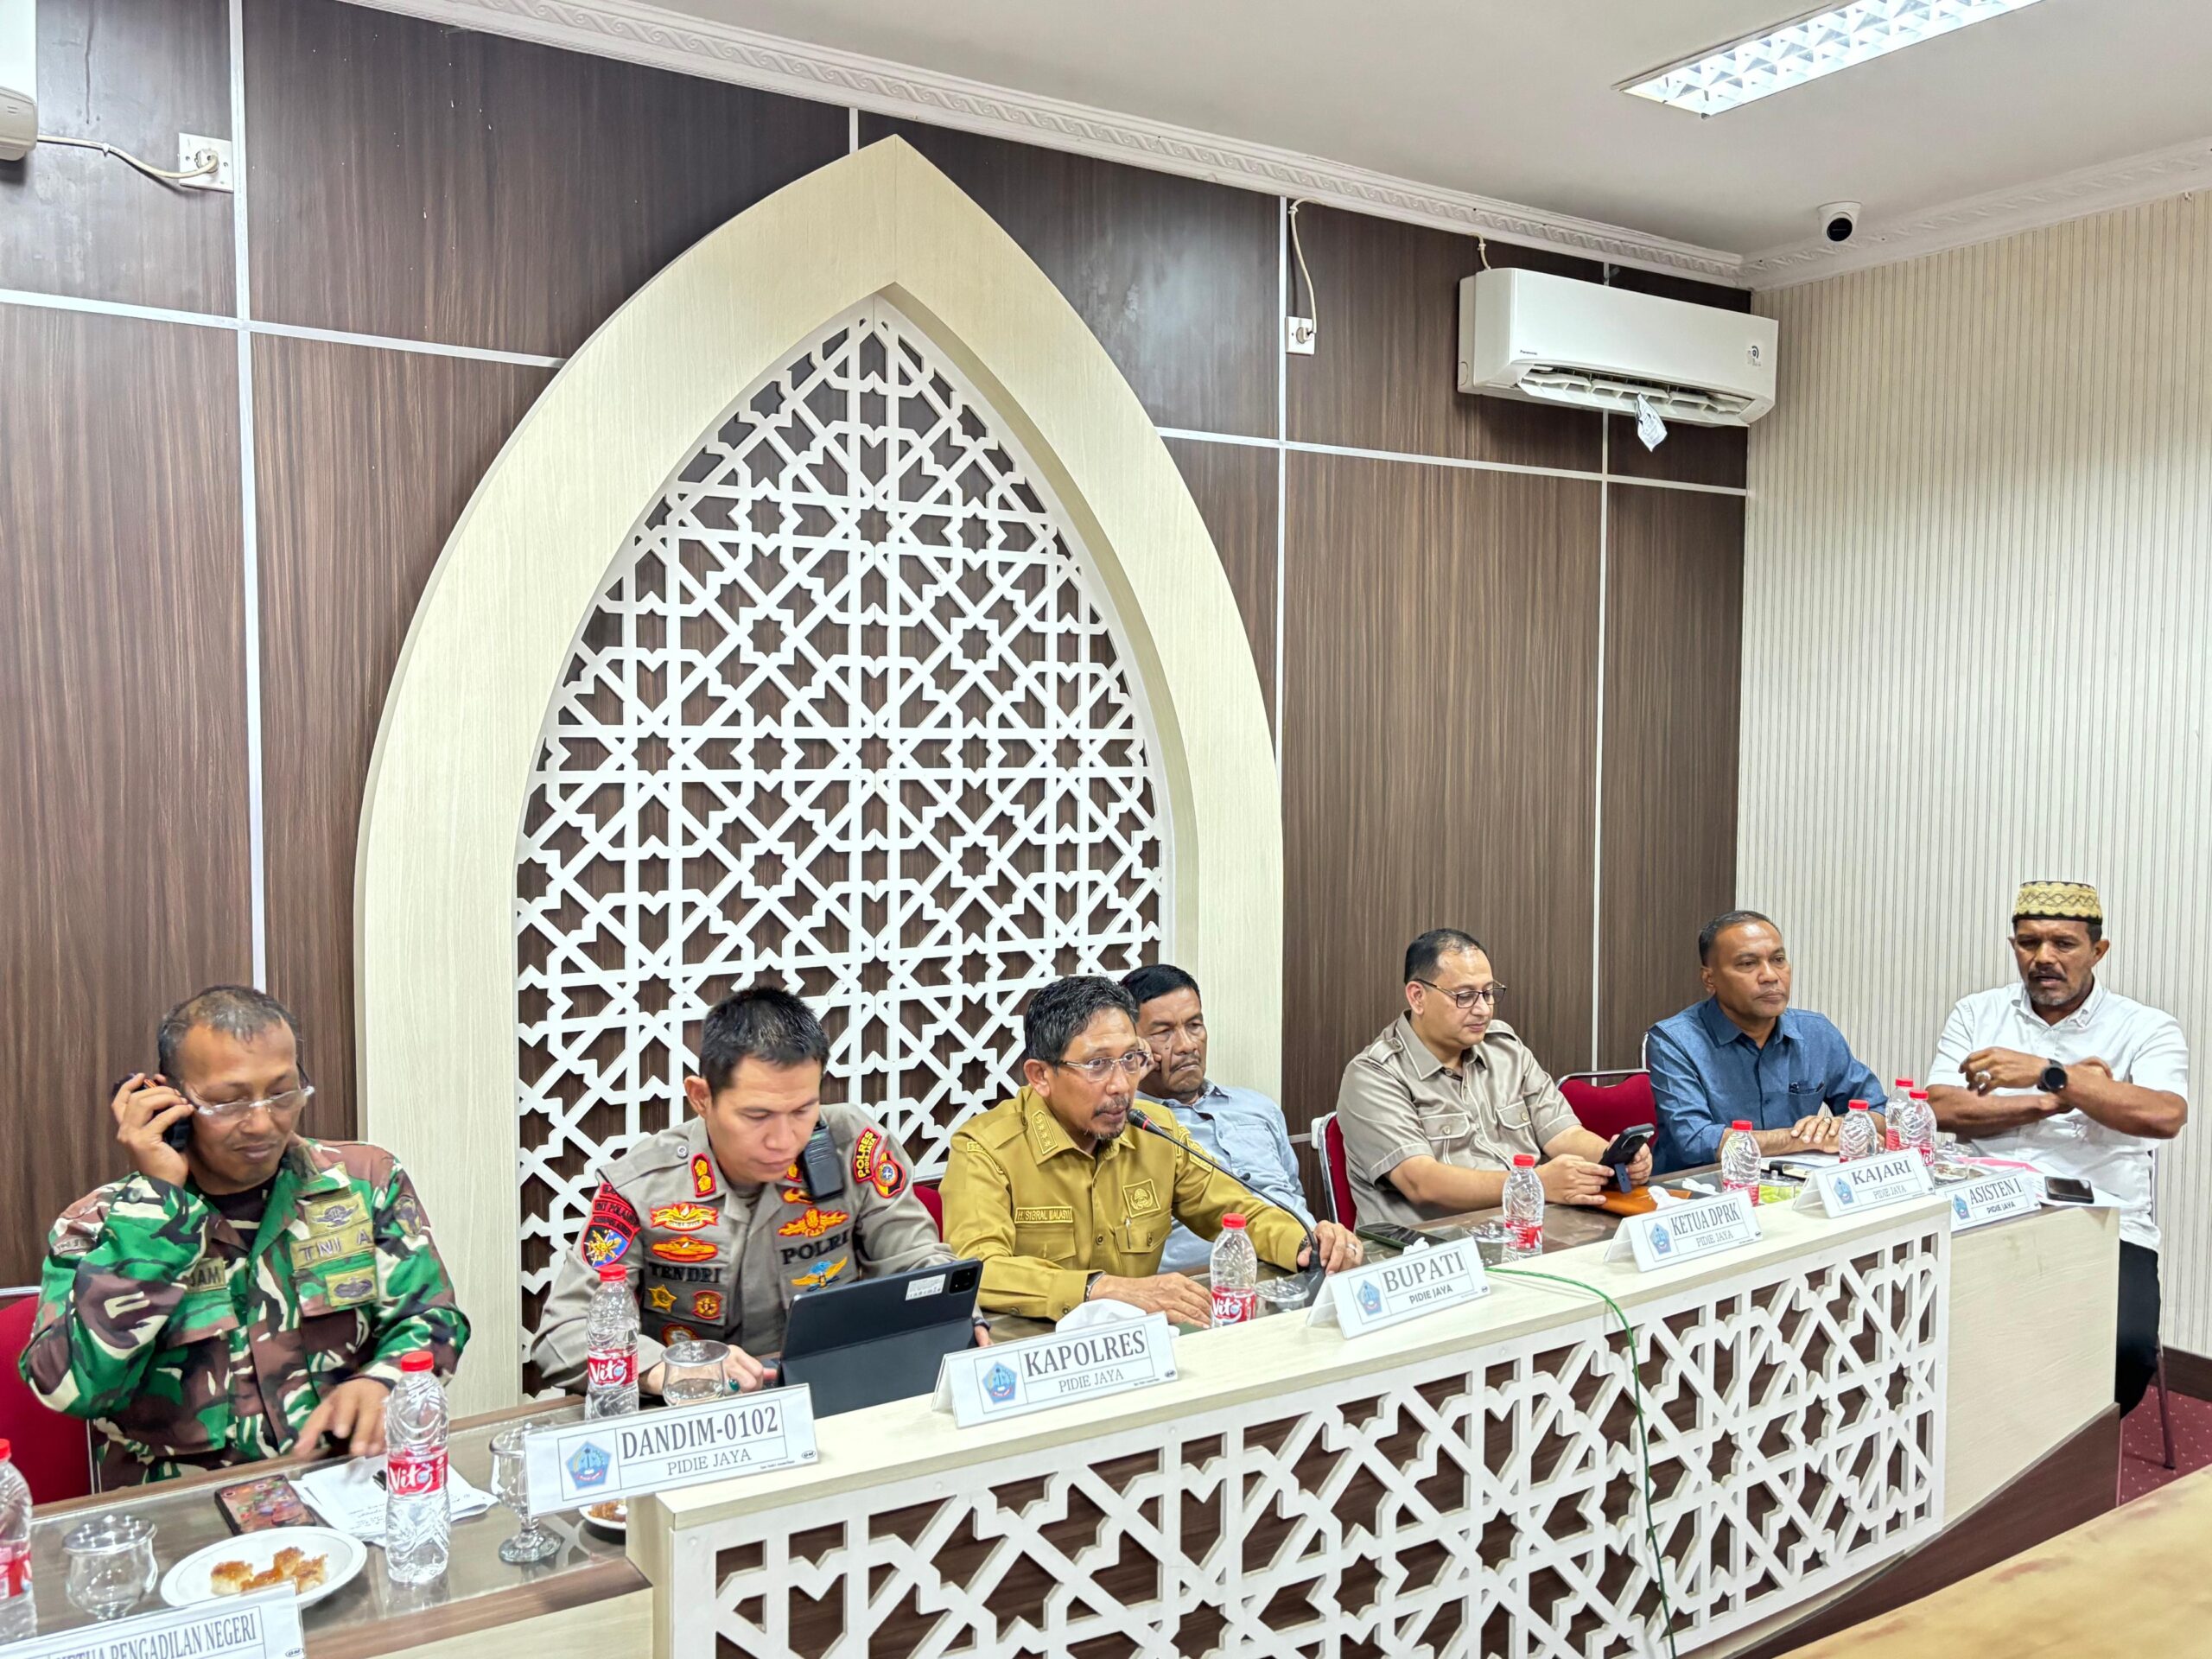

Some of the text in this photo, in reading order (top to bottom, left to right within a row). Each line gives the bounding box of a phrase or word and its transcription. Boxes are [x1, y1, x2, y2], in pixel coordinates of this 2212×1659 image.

[856, 1131, 874, 1178] POLRES
[1851, 1160, 1912, 1185] KAJARI
[1891, 1185, 1907, 1196] JAYA
[1969, 1179, 2015, 1205] ASISTEN
[1670, 1202, 1740, 1236] KETUA DPRK
[2002, 1201, 2016, 1211] JAYA
[298, 1237, 341, 1262] TNI
[780, 1230, 849, 1265] POLRI
[1695, 1230, 1734, 1248] PIDIE JAYA
[648, 1262, 722, 1283] TENDRI
[1382, 1251, 1465, 1293] BUPATI
[1409, 1291, 1432, 1305] PIDIE
[1433, 1284, 1453, 1298] JAYA
[1024, 1330, 1146, 1376] KAPOLRES
[589, 1359, 615, 1383] Vit
[1058, 1375, 1091, 1393] PIDIE
[1094, 1369, 1123, 1386] JAYA
[621, 1406, 779, 1459] DANDIM-0102
[667, 1456, 709, 1476] PIDIE
[713, 1448, 752, 1467] JAYA
[389, 1464, 417, 1491] Vit
[111, 1612, 257, 1659] PENGADILAN NEGERI
